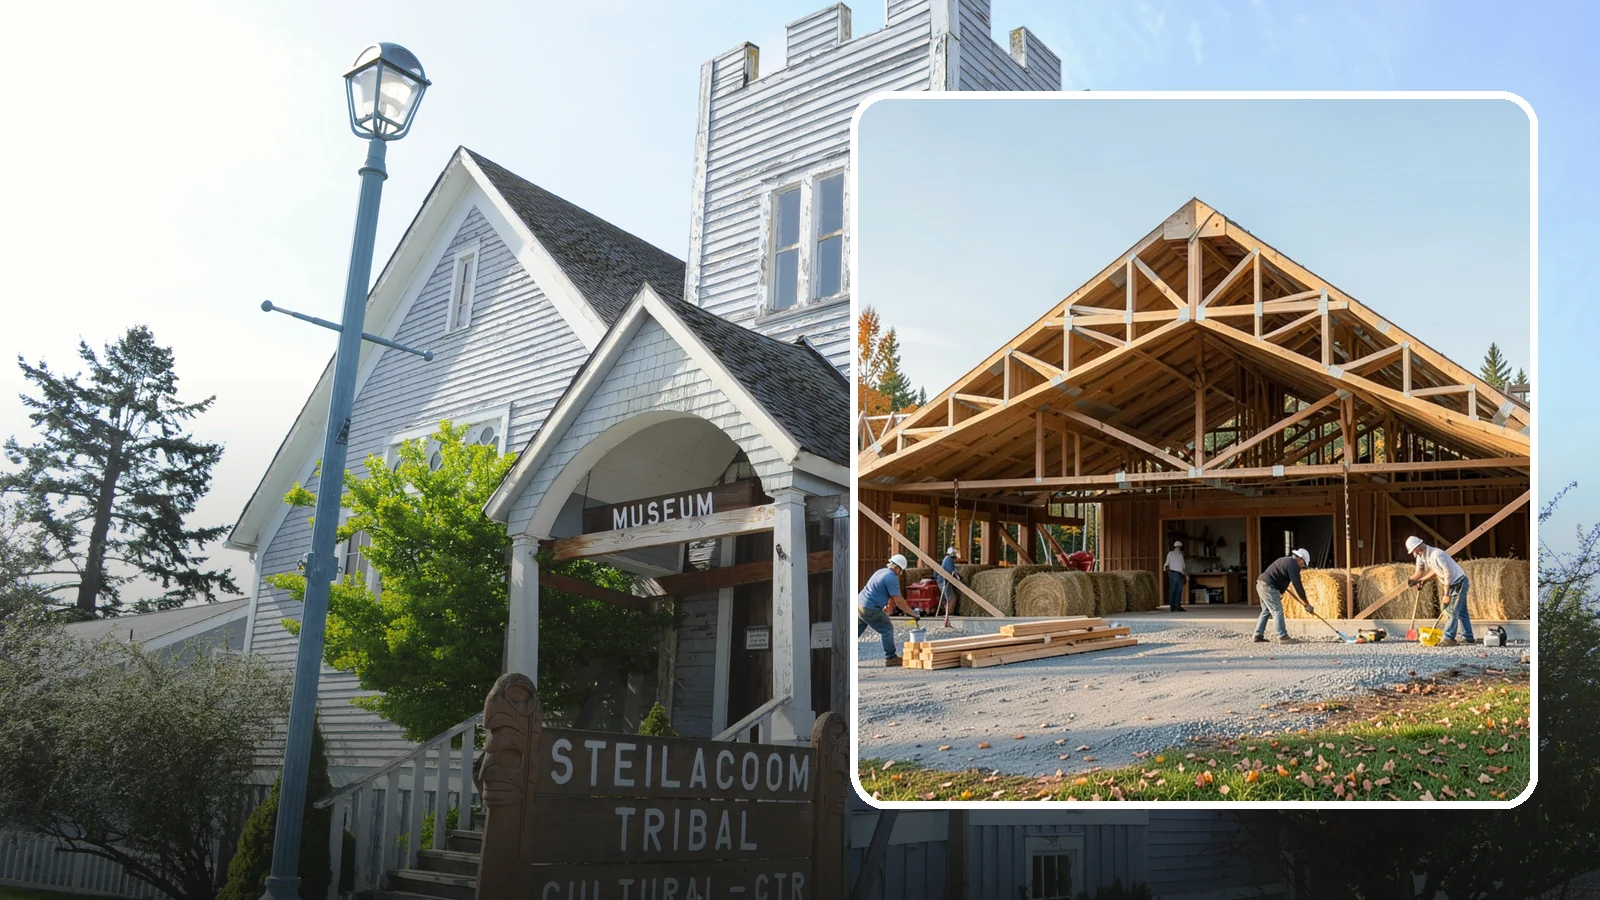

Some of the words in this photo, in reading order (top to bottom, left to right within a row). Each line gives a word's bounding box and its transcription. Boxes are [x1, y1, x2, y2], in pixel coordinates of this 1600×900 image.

[613, 492, 713, 530] MUSEUM
[550, 738, 810, 792] STEILACOOM
[615, 806, 758, 852] TRIBAL
